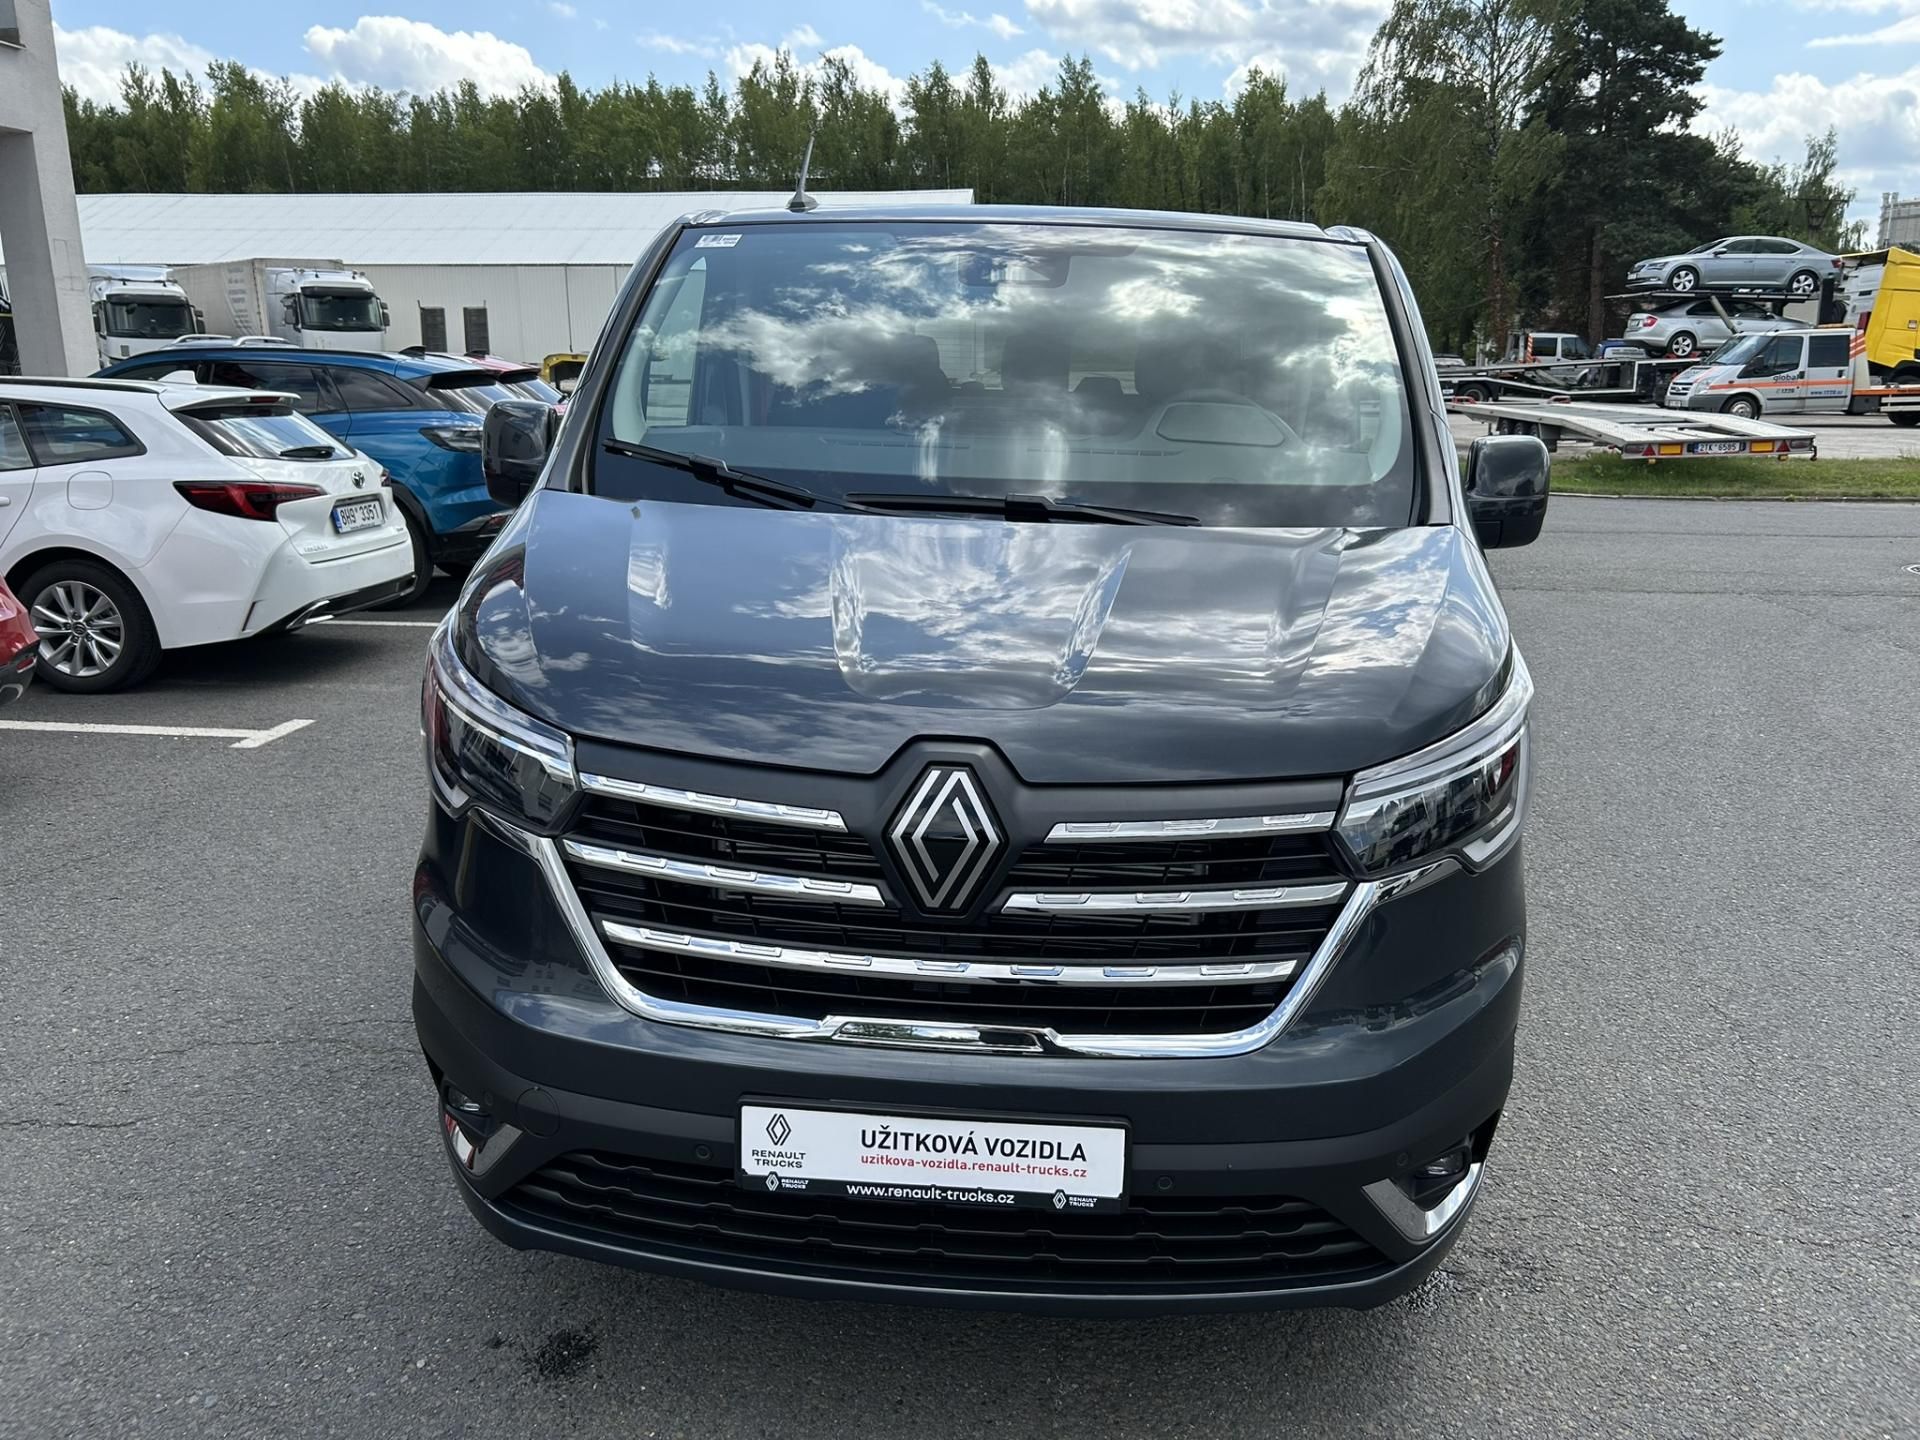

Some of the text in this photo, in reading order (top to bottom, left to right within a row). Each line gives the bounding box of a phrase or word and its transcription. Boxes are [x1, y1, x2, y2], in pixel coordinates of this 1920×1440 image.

[1772, 373, 1800, 383] global
[340, 507, 355, 526] 8H9
[359, 503, 380, 521] 3351
[861, 1124, 1087, 1162] UŽITKOVÁ VOZIDLA
[752, 1149, 806, 1160] RENAULT
[754, 1158, 803, 1169] TRUCKS
[861, 1154, 1087, 1178] uzitkova-vozidla.renault-trucks.cz
[846, 1184, 1015, 1204] www.renault-trucks.cz
